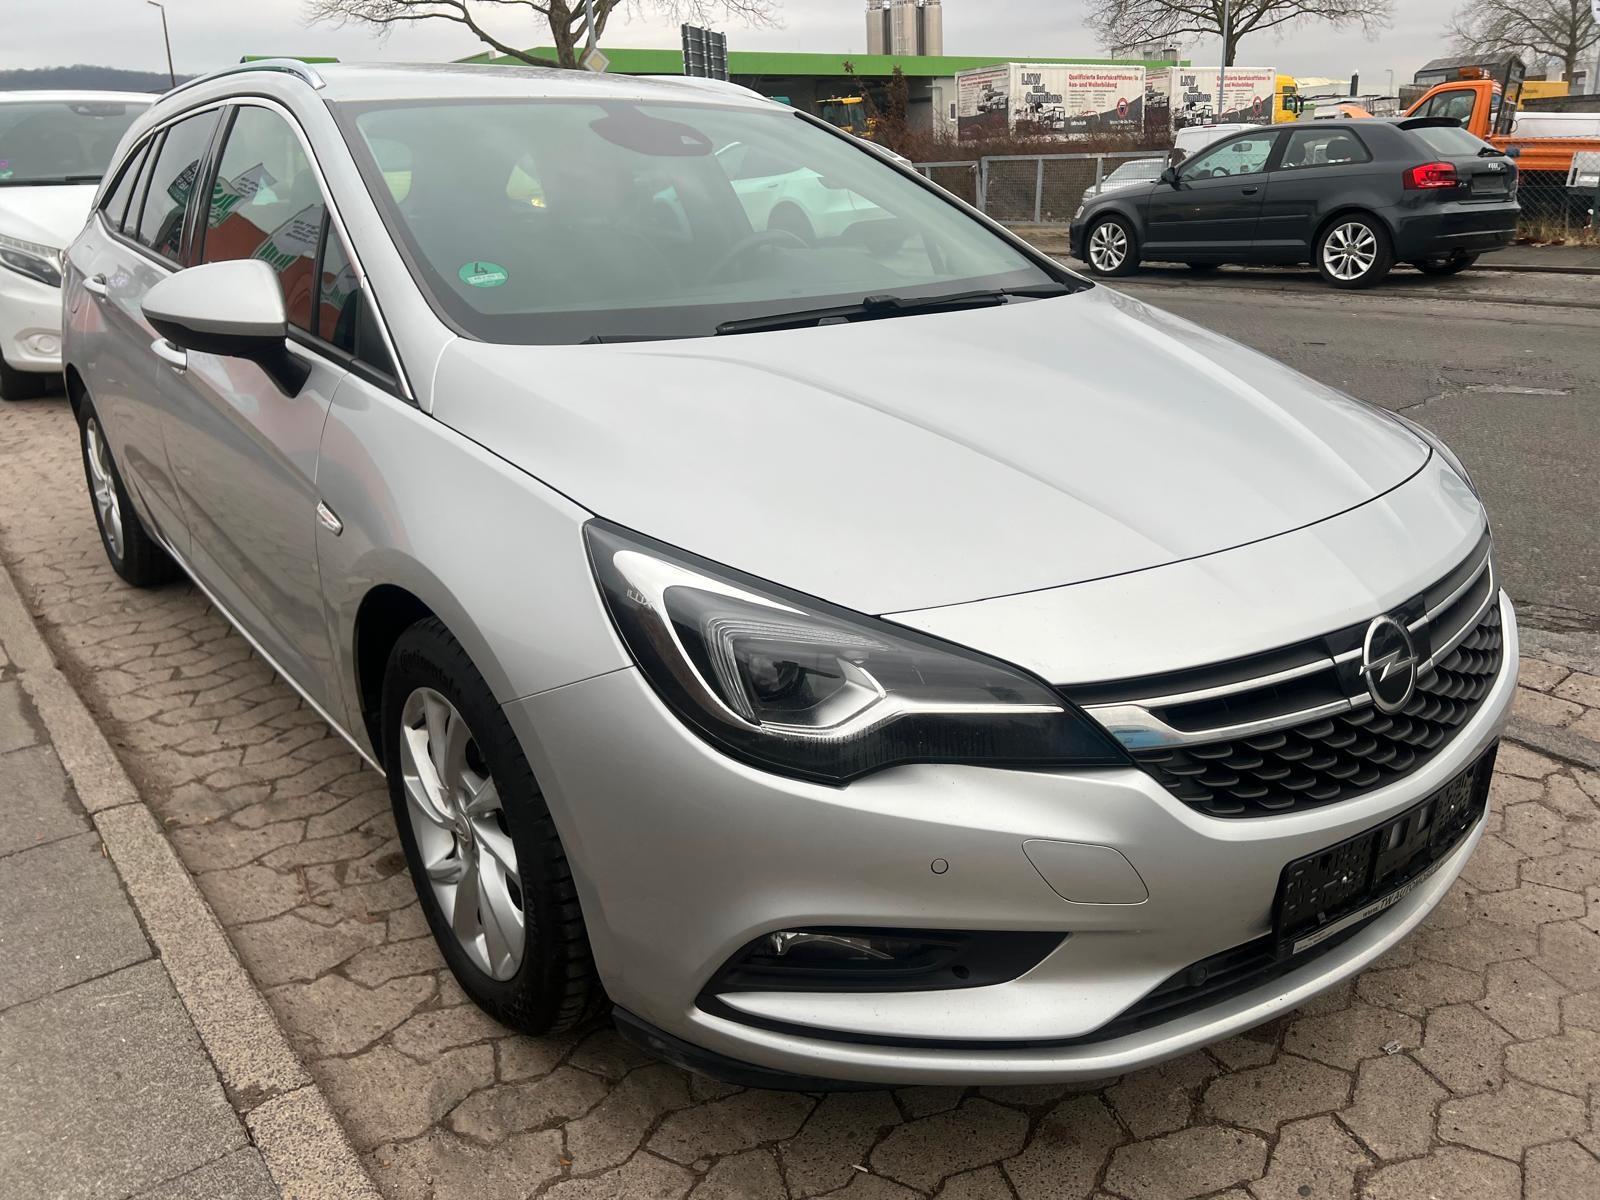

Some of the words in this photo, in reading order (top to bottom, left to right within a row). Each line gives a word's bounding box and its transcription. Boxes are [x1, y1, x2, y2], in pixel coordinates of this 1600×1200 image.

[1021, 73, 1041, 85] LKW
[1180, 75, 1196, 86] LKW
[1032, 84, 1045, 93] und
[1188, 85, 1199, 93] und
[1025, 91, 1062, 103] Omnibus
[1183, 92, 1212, 102] Omnibus
